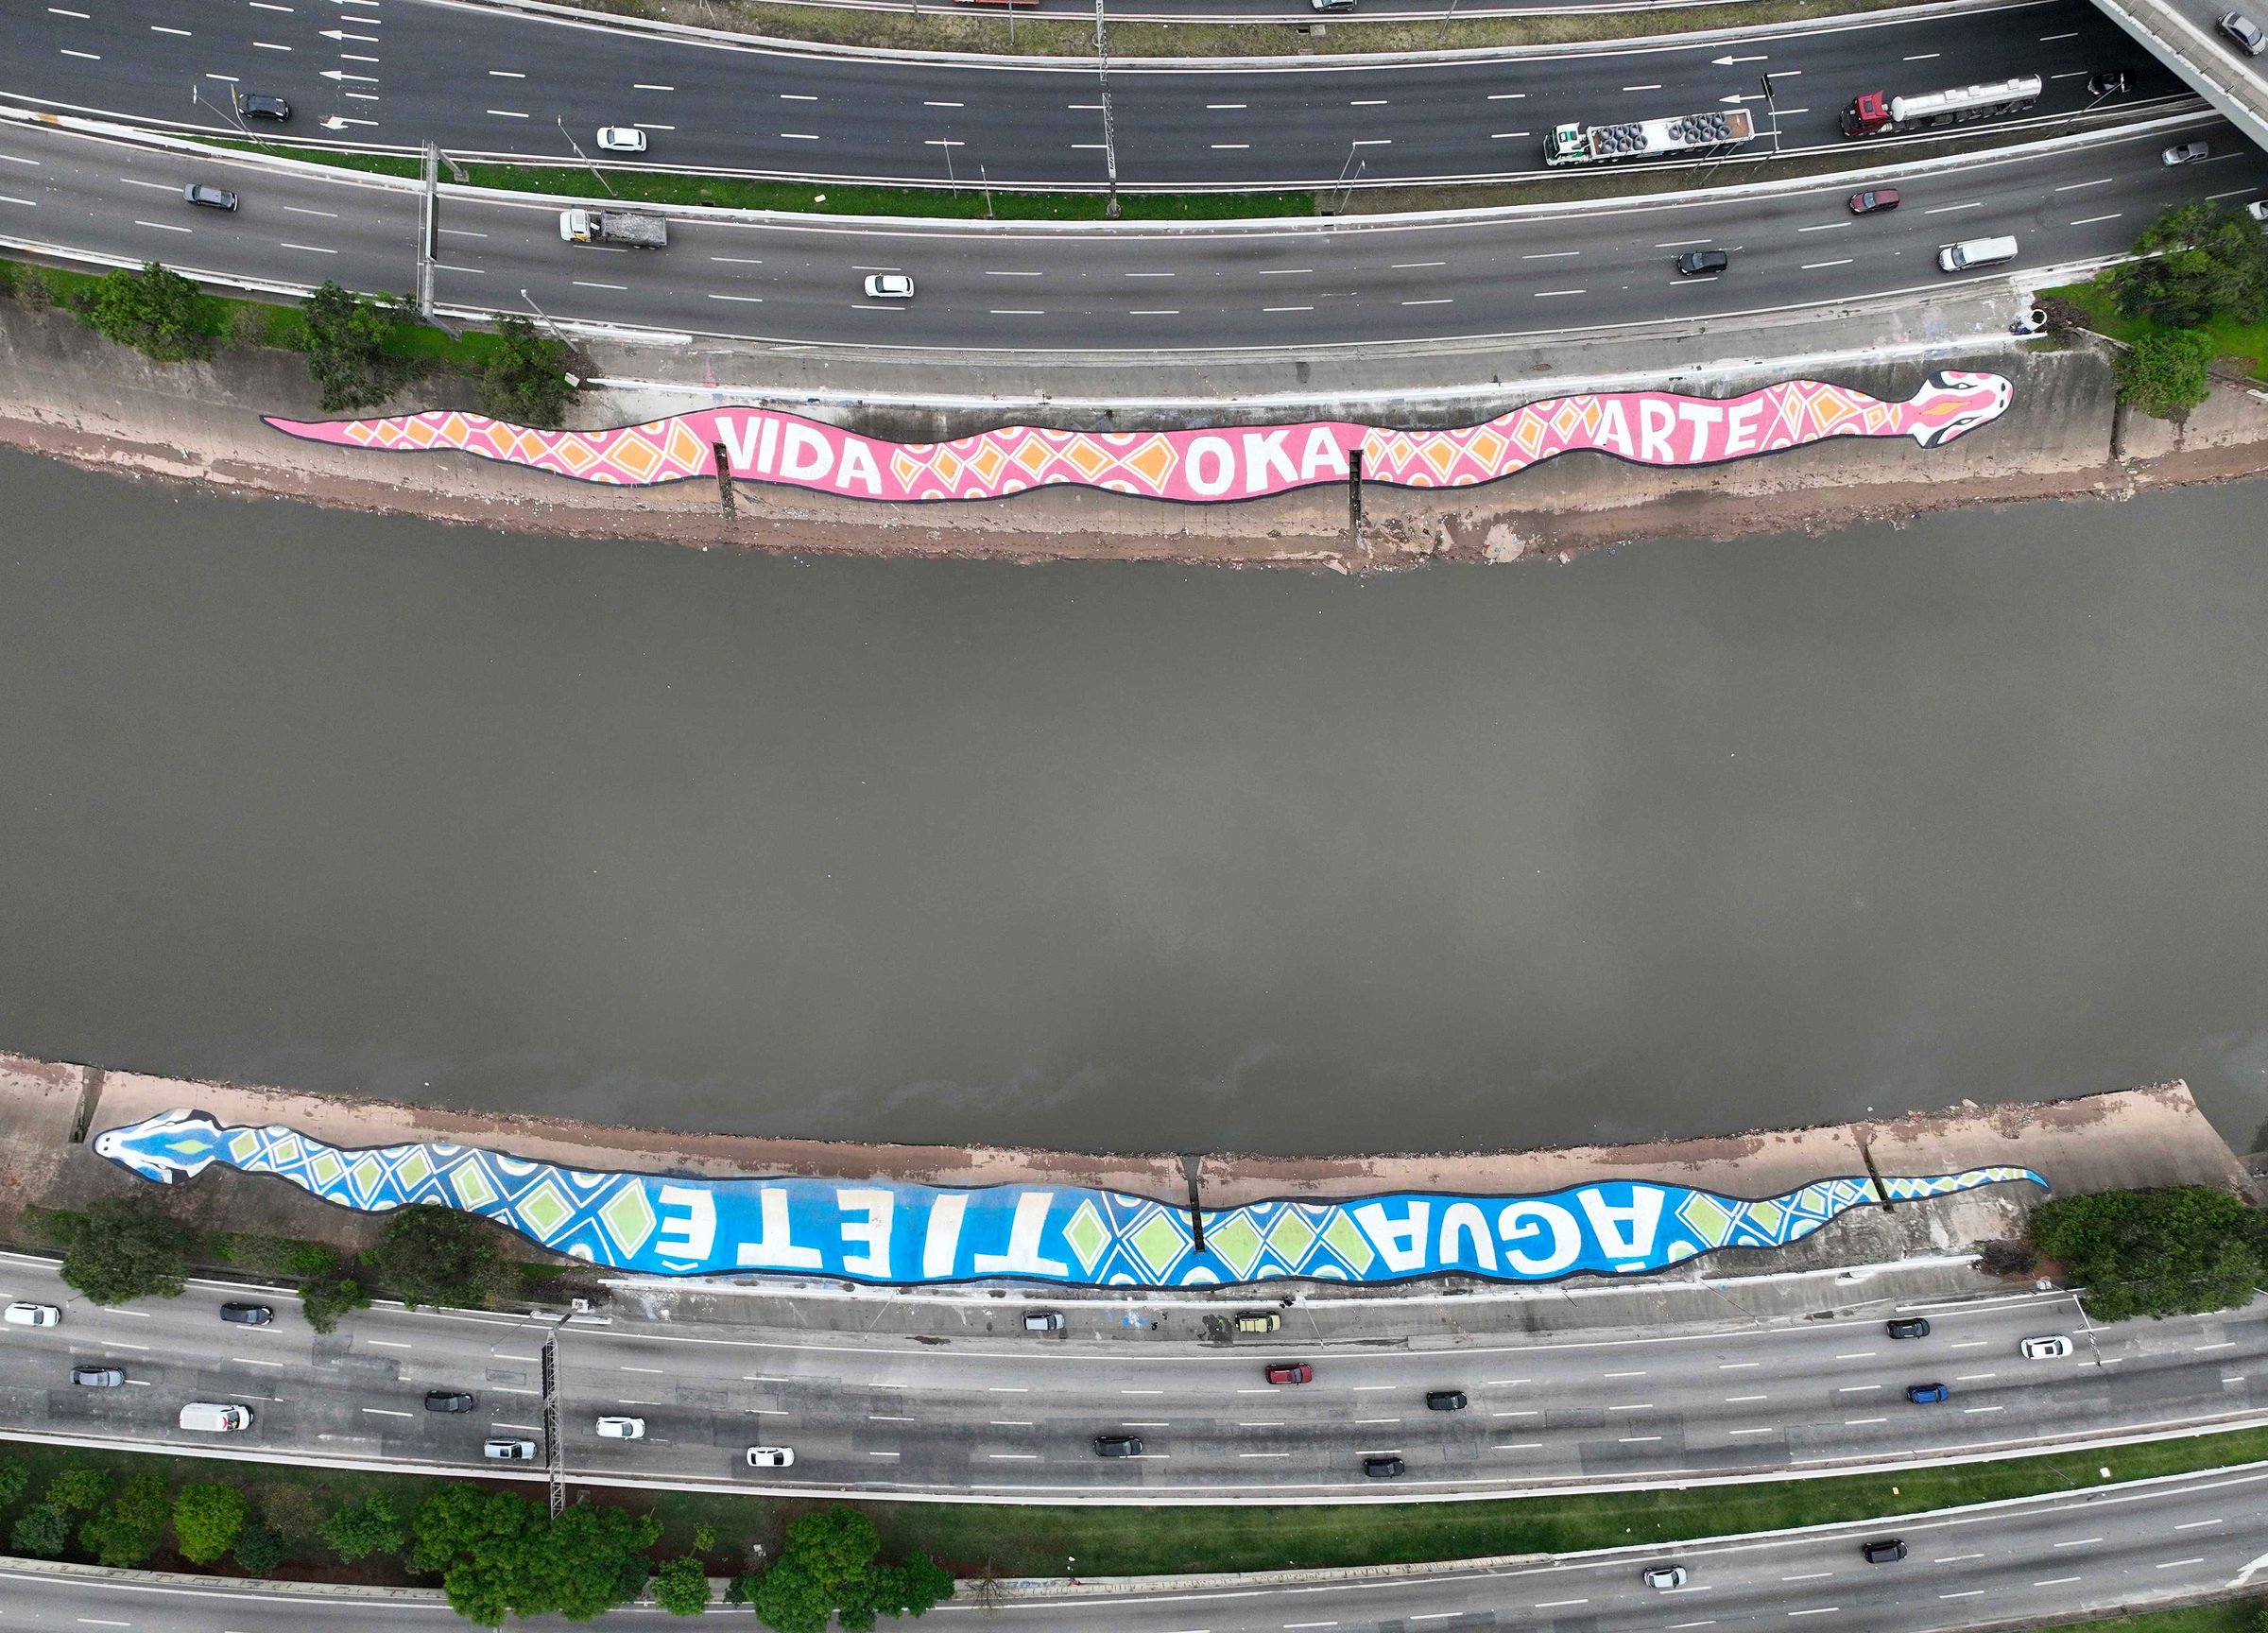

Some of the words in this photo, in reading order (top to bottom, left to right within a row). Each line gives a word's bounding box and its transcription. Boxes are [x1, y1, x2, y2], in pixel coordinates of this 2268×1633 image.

[714, 416, 883, 494] VIDA
[1185, 426, 1350, 495] OKA
[1592, 397, 1764, 462] ARTE
[655, 1184, 1069, 1278] TIETÊ
[1352, 1185, 1666, 1275] ÁGUA
